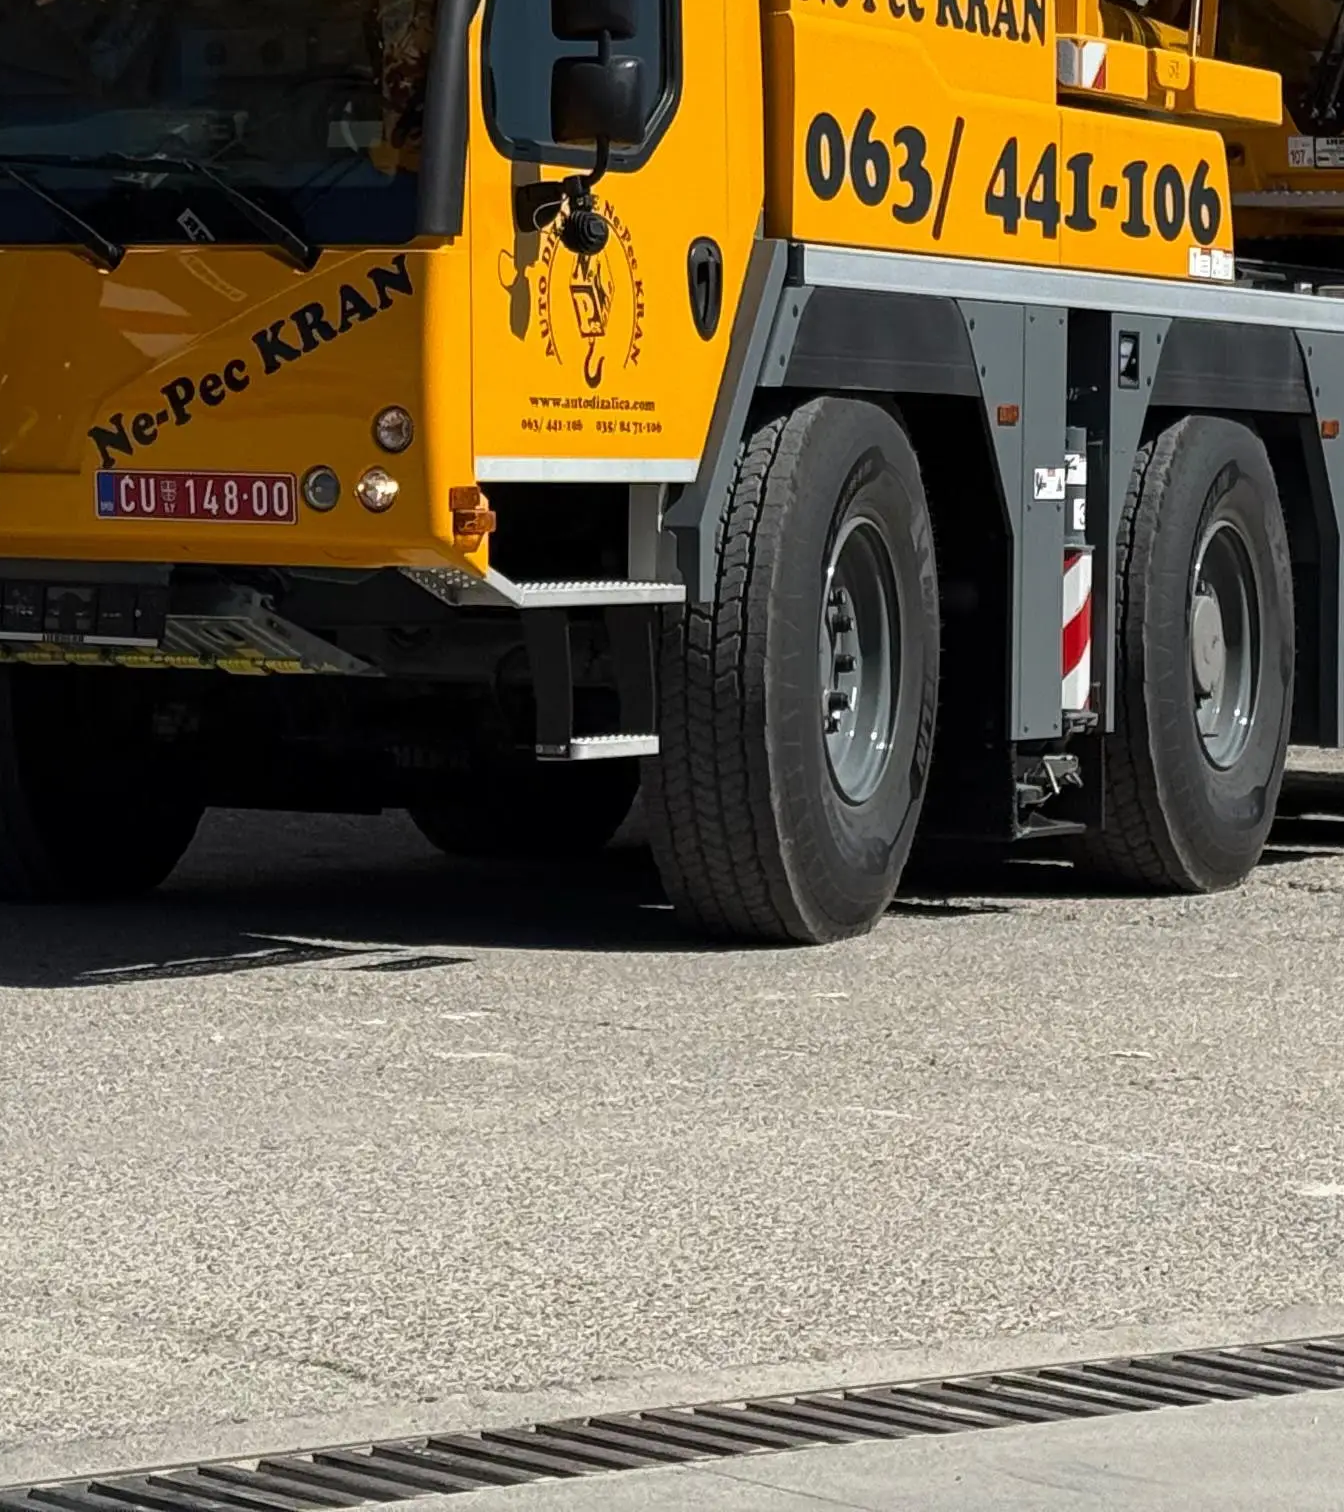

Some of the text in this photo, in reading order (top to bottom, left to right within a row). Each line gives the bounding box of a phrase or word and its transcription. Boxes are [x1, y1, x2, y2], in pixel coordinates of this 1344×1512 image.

[806, 109, 1220, 244] 063/ 441-106
[88, 253, 414, 468] Ne-Pec KRAN
